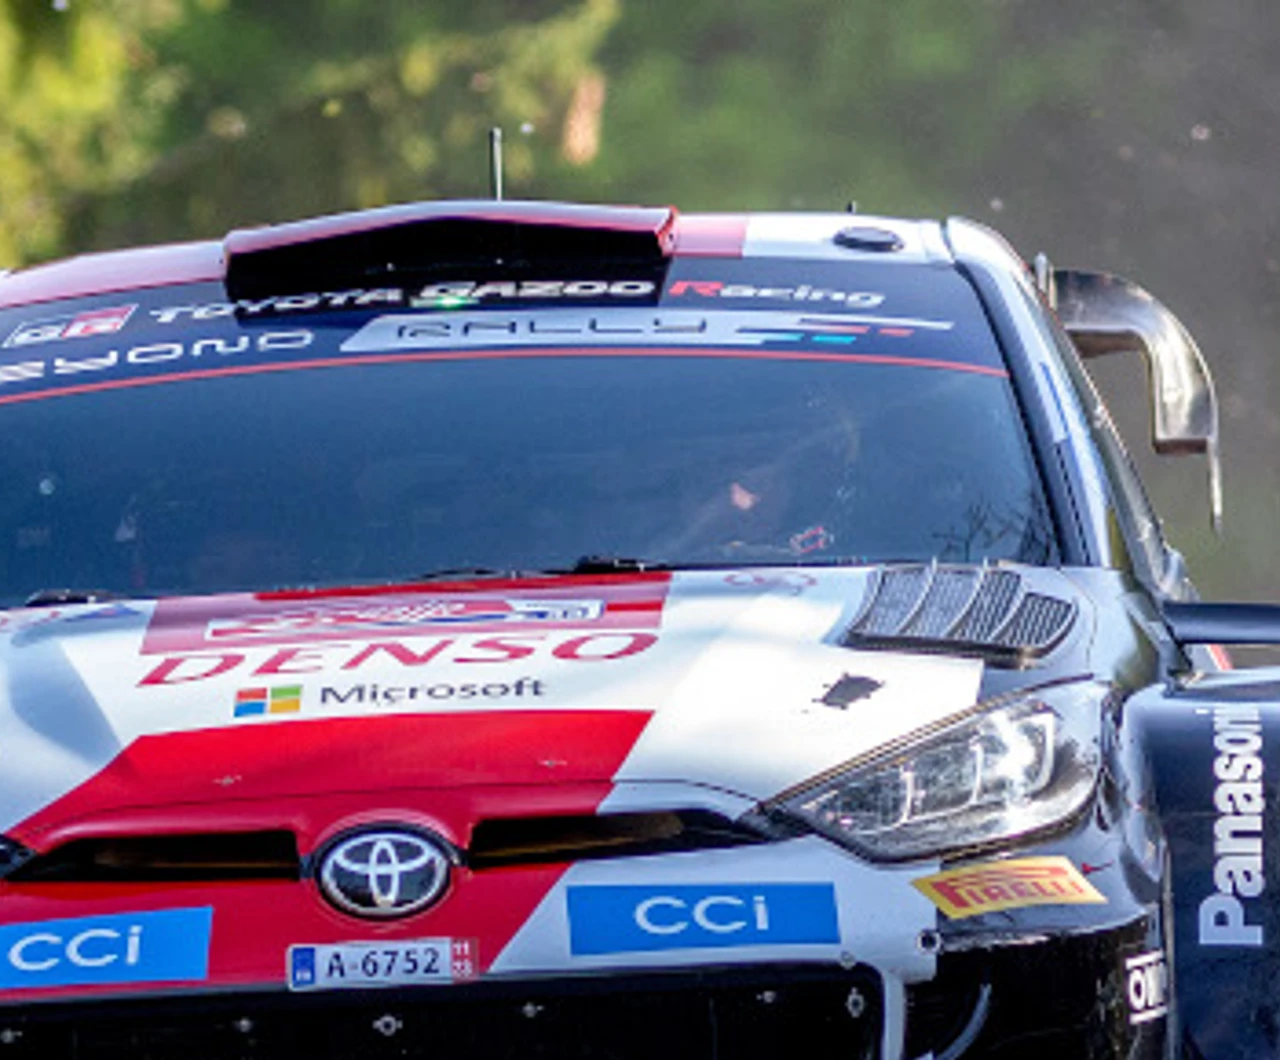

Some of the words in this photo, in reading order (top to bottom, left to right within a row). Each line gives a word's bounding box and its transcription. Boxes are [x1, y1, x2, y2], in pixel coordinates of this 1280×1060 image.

[148, 287, 403, 323] TOYOTA
[417, 279, 655, 306] GAZOO
[669, 279, 886, 309] Racing
[396, 319, 707, 338] RALLY
[135, 632, 660, 688] DENSO
[320, 677, 549, 707] Microsoft
[1194, 702, 1265, 945] Panasoni
[932, 862, 1088, 910] PIRELLI
[326, 947, 441, 978] A-6752
